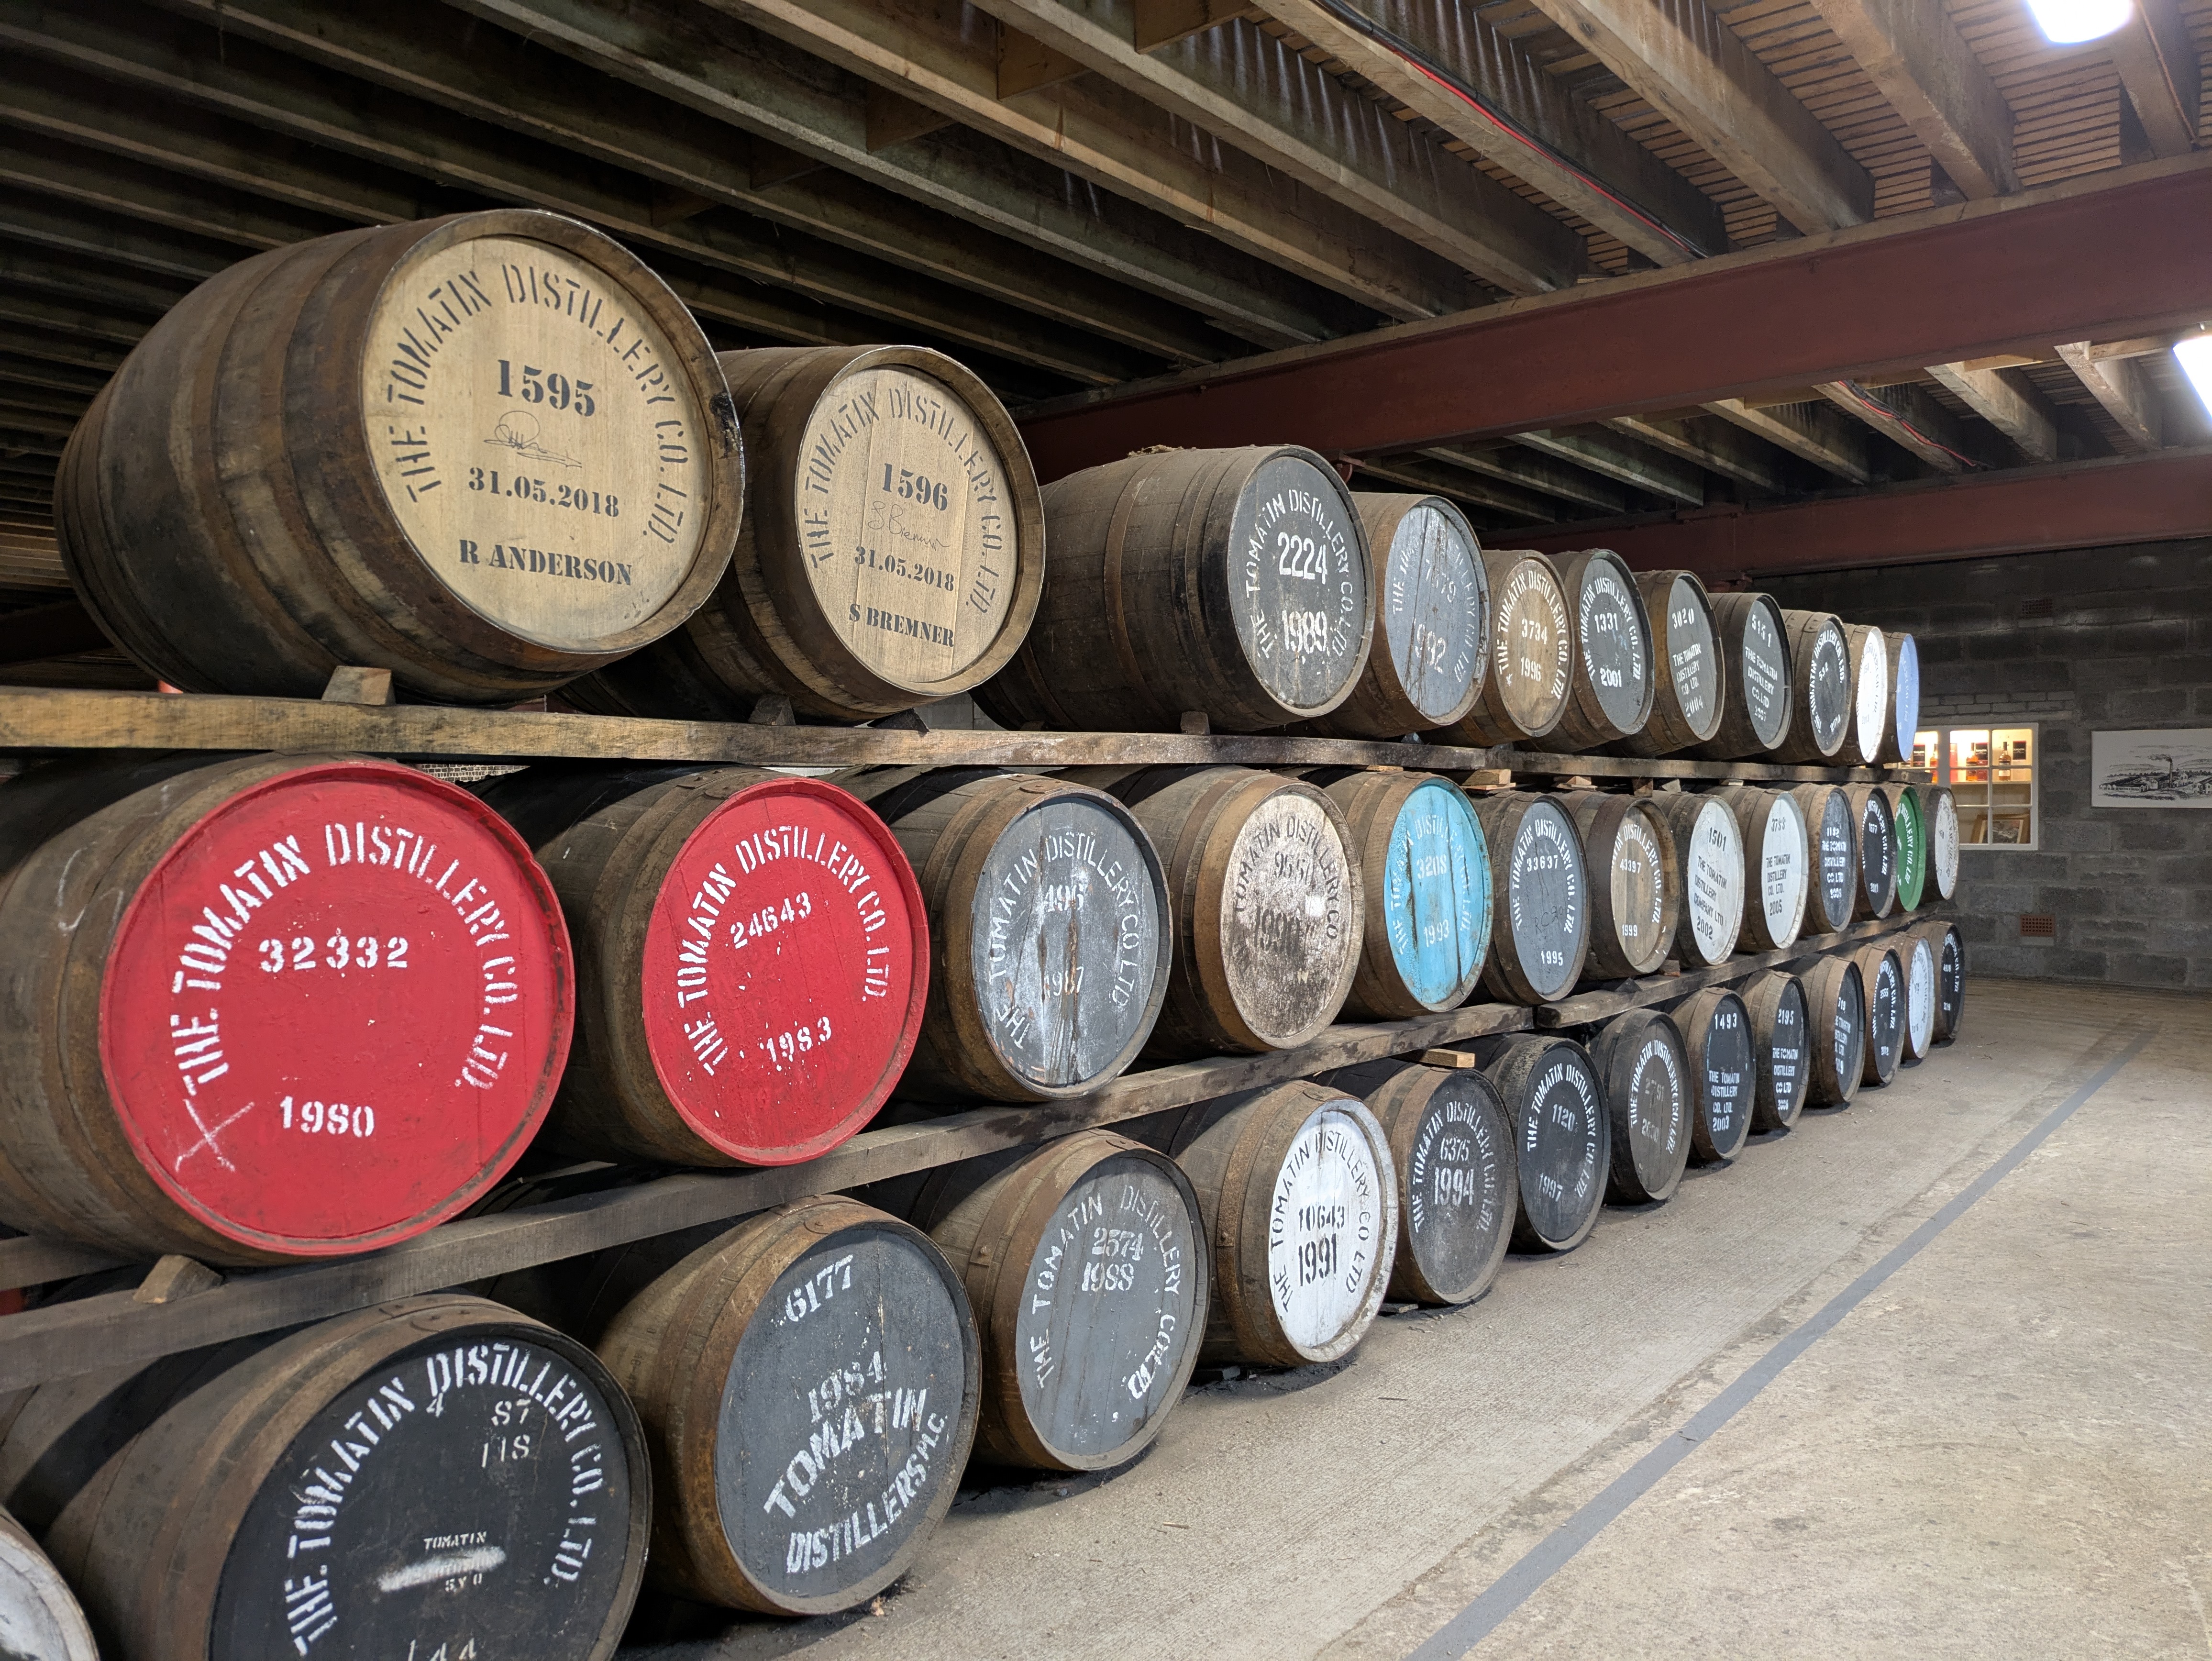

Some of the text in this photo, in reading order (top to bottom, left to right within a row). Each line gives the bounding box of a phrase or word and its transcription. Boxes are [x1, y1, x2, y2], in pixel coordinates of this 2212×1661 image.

[387, 271, 491, 406] TOMATIN
[502, 265, 675, 404] DISTILLERY
[498, 360, 596, 417] 1595
[654, 420, 688, 473] CO.
[805, 392, 879, 493] TOMATIN
[889, 388, 996, 502] DISTILLERY
[389, 426, 442, 502] THE
[469, 467, 619, 517] 31.05.2018
[882, 463, 948, 511] 1596
[805, 510, 834, 567] THE
[459, 539, 632, 586] R ANDERSON
[854, 546, 954, 592] 31.05.2018
[1246, 489, 1349, 658] THE TOMATIN DISTILLERY
[1278, 532, 1327, 585] 2224
[849, 603, 954, 647] S BREMNER
[1282, 610, 1327, 654] 1989
[1497, 570, 1566, 675] THE TOMATIN DISTILLERY
[1522, 618, 1548, 645] 3734
[1581, 577, 1633, 680] THE TOMATIN DISTILLERY
[1594, 612, 1618, 632] 1331
[1672, 608, 1694, 629] 3020
[1672, 643, 1701, 666] THE TOMATIN
[1814, 630, 1836, 659] DISTILLERY
[1521, 657, 1541, 682] 1996
[1600, 667, 1622, 687] 2001
[1677, 659, 1700, 683] DISTILLERY
[1745, 647, 1777, 681] THE TOMATIN
[1748, 666, 1774, 695] DISTILLERY
[1819, 662, 1828, 681] 532
[1685, 696, 1703, 717] 2004
[1535, 819, 1572, 870] DISTILLERY
[1624, 824, 1659, 867] DISTILLERY
[1709, 827, 1726, 852] 1501
[1233, 821, 1280, 912] TOMATIN
[1287, 816, 1341, 903] DISTILLERY
[1416, 853, 1447, 880] 3208
[1512, 825, 1533, 889] TOMATIN
[1526, 855, 1558, 872] 33637
[1619, 859, 1641, 873] 43397
[1774, 853, 1790, 866] TOMATIN
[1694, 875, 1716, 901] DISTILLERY
[1707, 864, 1727, 889] TOMATIN
[1767, 869, 1787, 883] DISTILLERY
[1827, 872, 1844, 883] CO LTD
[171, 821, 518, 1015] TOMATIN DISTILLERY CO.
[730, 892, 812, 950] 24643
[1513, 897, 1522, 931] THE
[1694, 893, 1714, 918] COMPANY
[1770, 900, 1782, 916] 2005
[989, 831, 1140, 1050] THE TOMATIN DISTILLERY
[1424, 919, 1449, 947] 1993
[1622, 924, 1637, 937] 1999
[1697, 916, 1713, 940] 2002
[258, 936, 409, 973] 32332
[677, 826, 886, 1076] THE TOMATIN DISTILLERY CO.
[1541, 951, 1563, 966] 1995
[1715, 1013, 1737, 1030] 1493
[1778, 1008, 1794, 1025] 2195
[765, 1016, 832, 1062] 1983
[1780, 1049, 1798, 1060] TOMATIN
[1632, 1041, 1652, 1093] TOMATIN
[1654, 1040, 1678, 1098] DISTILLERY
[1709, 1070, 1740, 1084] THE TOMATIN
[1773, 1065, 1795, 1076] DISTILLERY
[1711, 1086, 1737, 1097] DISTILLERY
[1776, 1082, 1783, 1093] CO
[280, 1096, 375, 1138] 1980
[1527, 1063, 1596, 1152] THE TOMATIN DISTILLERY
[1552, 1104, 1575, 1131] 1120
[1713, 1115, 1729, 1132] 2003
[1440, 1136, 1470, 1161] 6375
[1413, 1100, 1494, 1233] THE TOMATIN DISTILLERY
[1434, 1167, 1474, 1206] 1994
[1539, 1173, 1563, 1202] 1997
[1271, 1130, 1371, 1313] THE TOMATIN DISTILLERY CO LTD
[1298, 1205, 1345, 1232] 10643
[1092, 1227, 1144, 1261] 2574
[1298, 1233, 1337, 1286] 1991
[785, 1253, 853, 1322] 6177
[1030, 1185, 1181, 1389] THE TOMATIN DISTILLERY
[1081, 1262, 1134, 1291] 1988
[808, 1350, 886, 1423] 1984
[288, 1376, 414, 1558] TOMATIN
[425, 1341, 597, 1443] DISTILLERY
[763, 1387, 929, 1519] TOMATIN
[787, 1454, 928, 1573] DISTILLERS
[423, 1531, 487, 1550] TOMATIN
